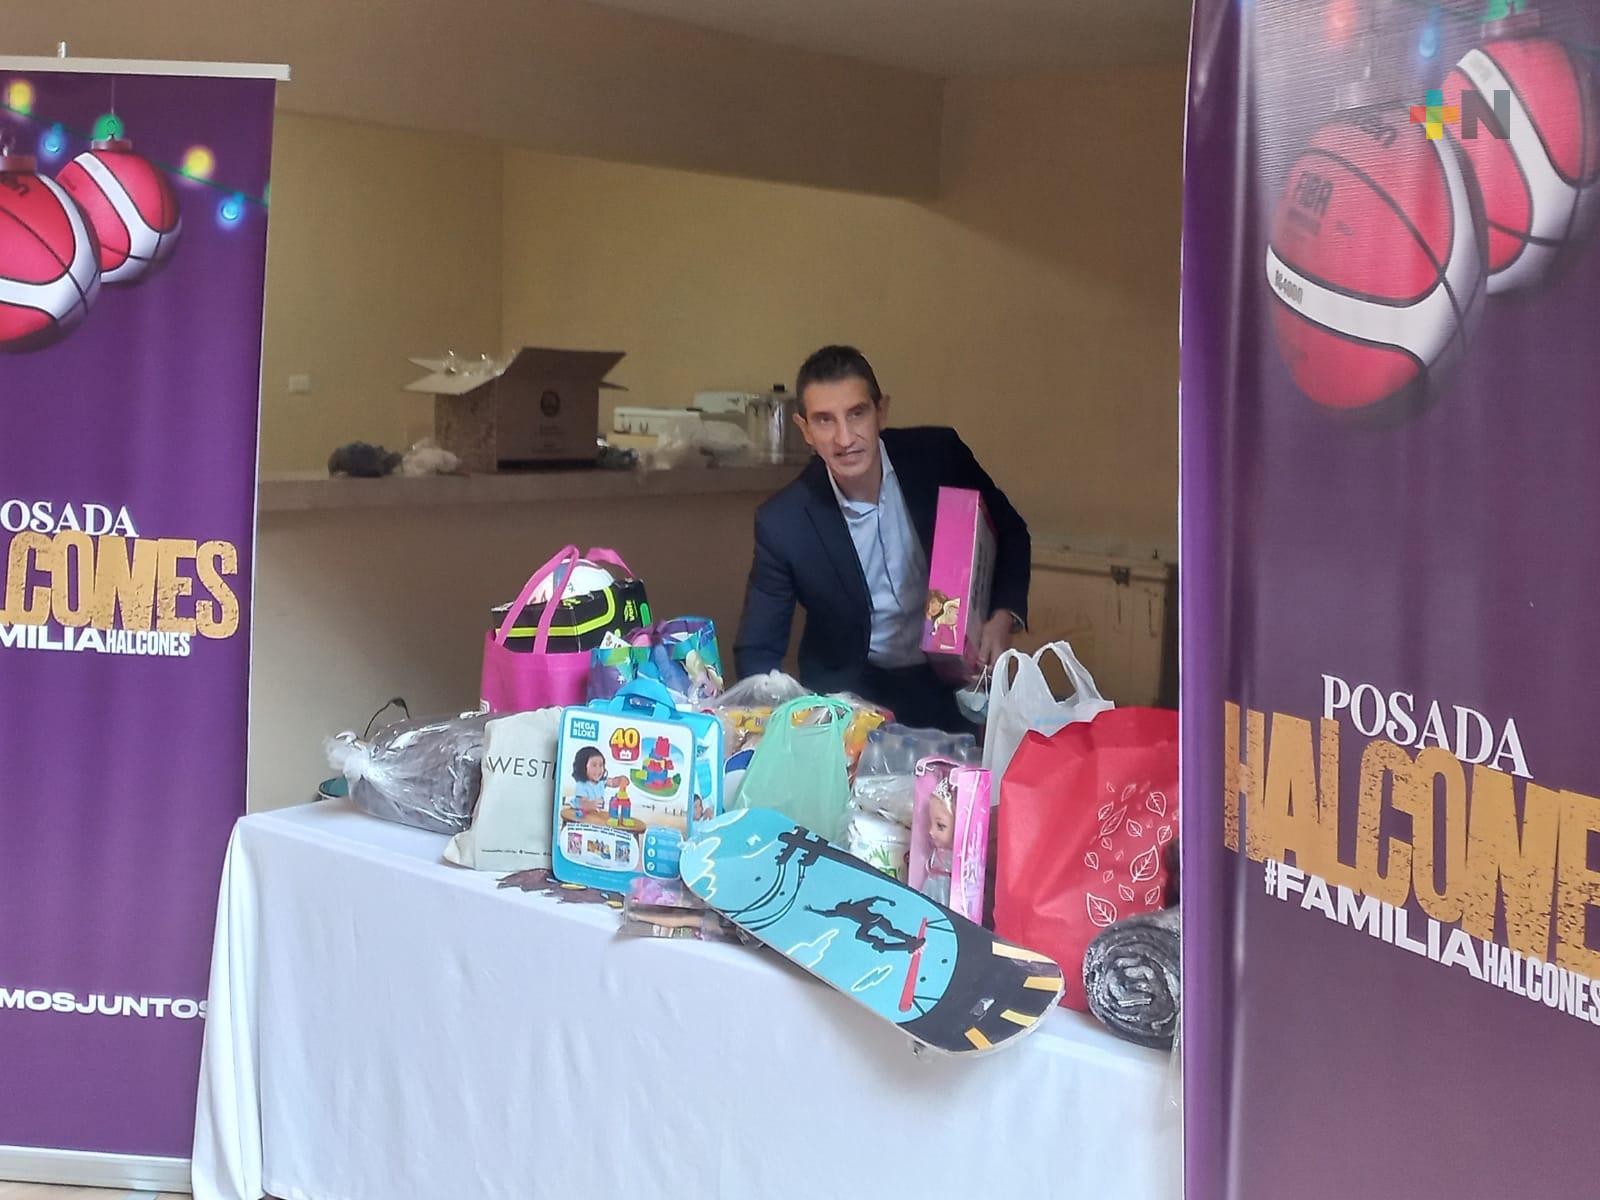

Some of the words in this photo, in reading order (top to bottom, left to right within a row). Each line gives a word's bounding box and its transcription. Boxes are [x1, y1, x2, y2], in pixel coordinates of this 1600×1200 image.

[0, 530, 240, 639] CONES
[573, 720, 596, 731] MEGA
[610, 728, 640, 749] 40
[1321, 673, 1534, 779] POSADA
